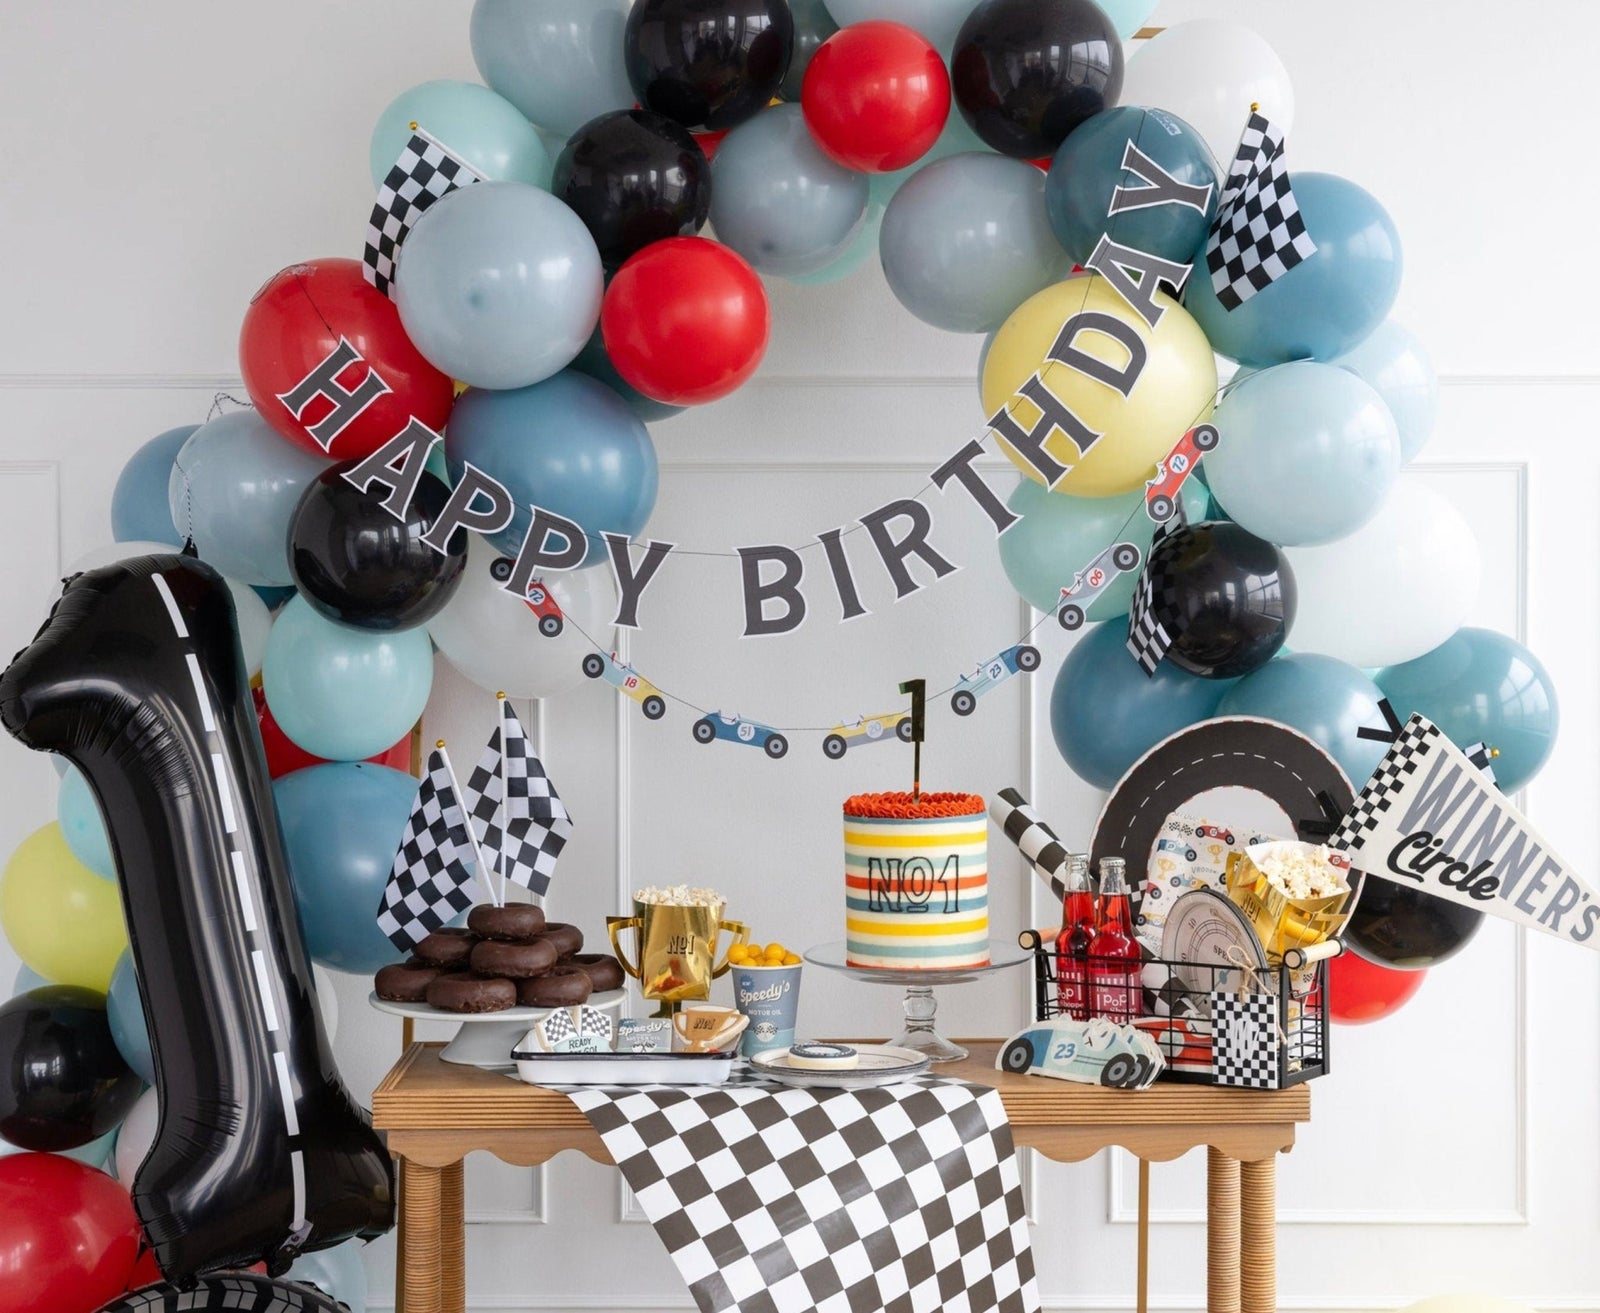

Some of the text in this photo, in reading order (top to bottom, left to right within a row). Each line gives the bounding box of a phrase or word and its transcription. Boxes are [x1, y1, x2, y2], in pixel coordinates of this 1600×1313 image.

[275, 137, 1215, 640] HAPPY BIRTHDAY
[1172, 454, 1186, 472] 72
[989, 664, 1002, 679] 23
[625, 676, 638, 689] 18
[739, 725, 752, 738] 51
[1396, 748, 1600, 942] WINNER'S
[1386, 830, 1501, 901] Circle
[740, 979, 791, 1007] Speedy's
[568, 1037, 592, 1050] READY
[1053, 1043, 1076, 1060] 23
